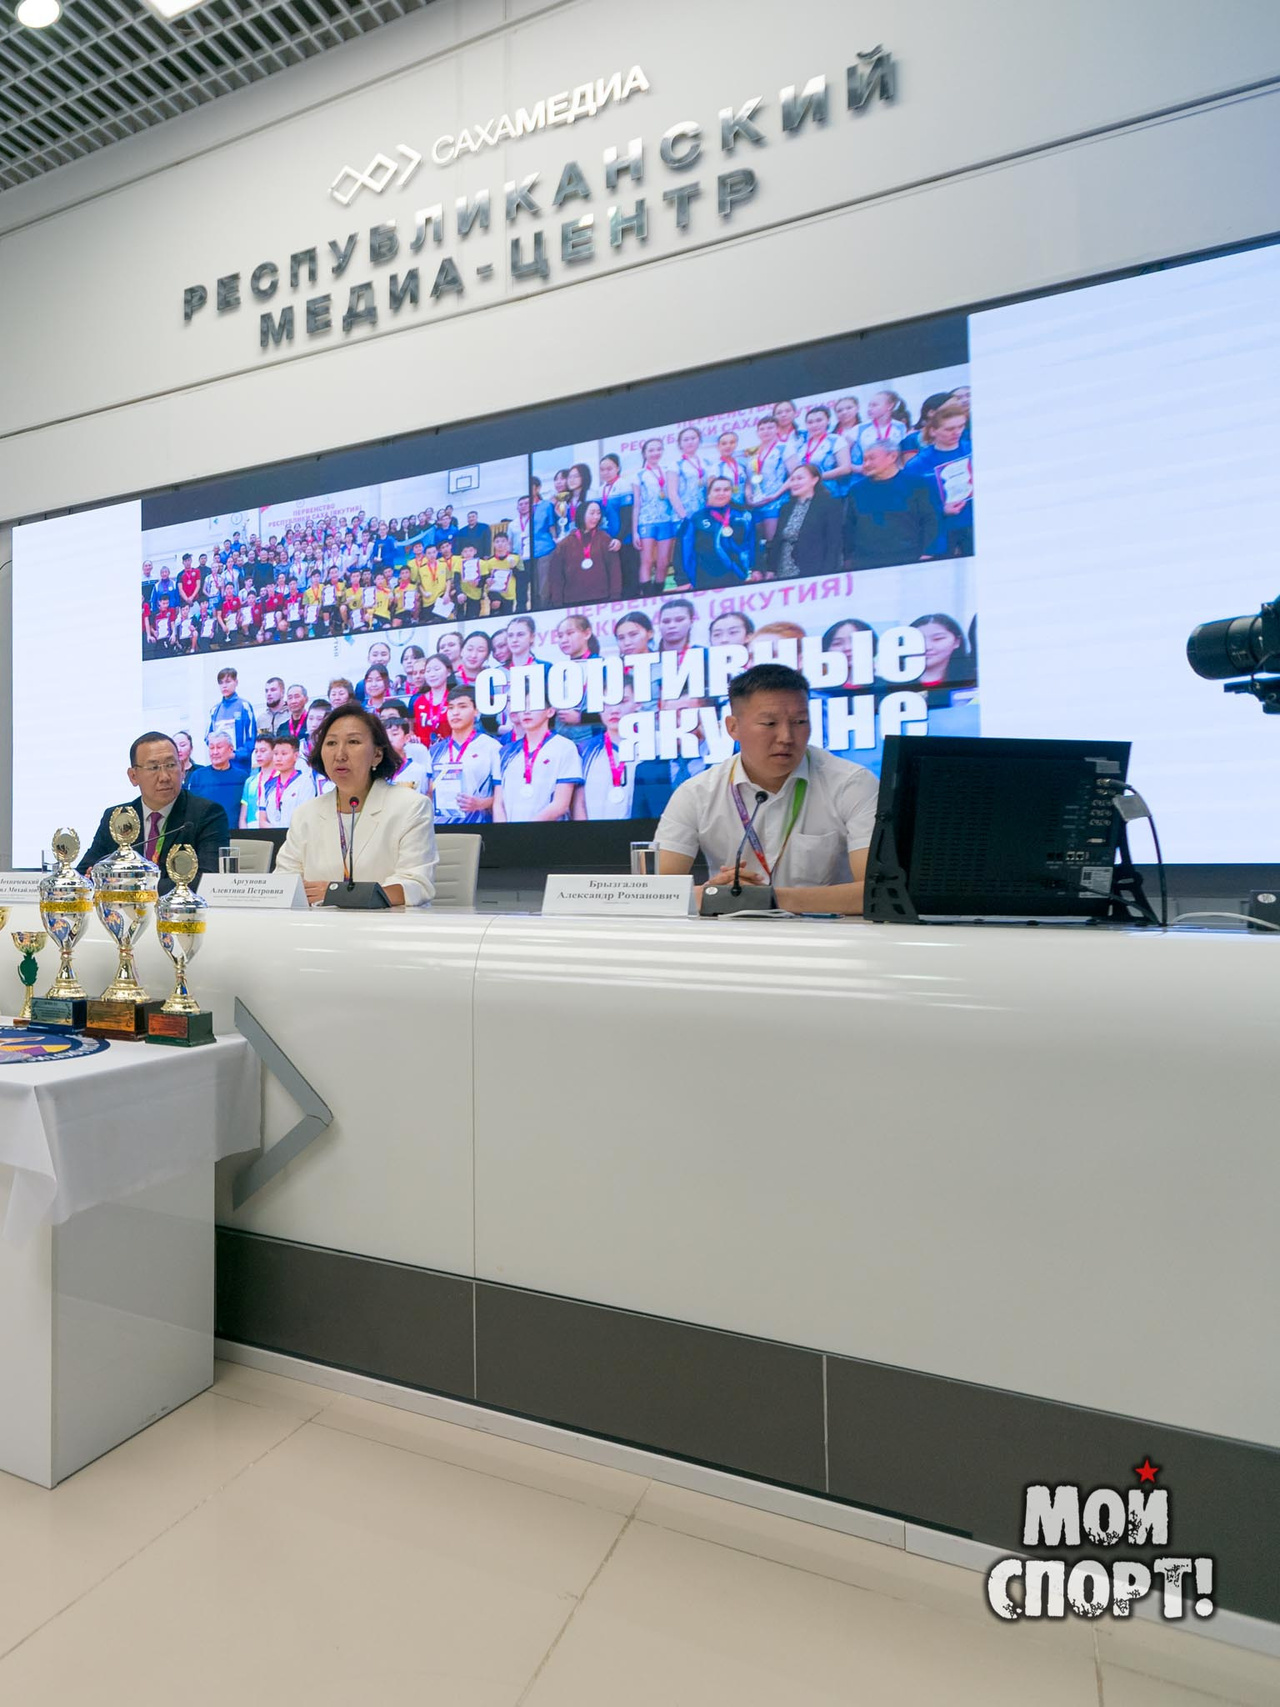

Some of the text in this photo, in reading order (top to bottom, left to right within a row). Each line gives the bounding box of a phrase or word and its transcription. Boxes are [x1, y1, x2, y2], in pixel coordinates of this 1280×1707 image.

[431, 64, 650, 167] САХАМЕДИА
[183, 44, 899, 322] РЕСПУБЛИКАНСКИЙ
[260, 167, 759, 351] МЕДИА-ЦЕНТР
[708, 573, 854, 621] (ЯКУТИЯ)
[619, 690, 928, 765] якуне
[231, 878, 267, 886] Аргунова
[247, 887, 284, 896] Петровна
[557, 891, 680, 901] Александр Романович
[589, 880, 648, 889] Брызгалов
